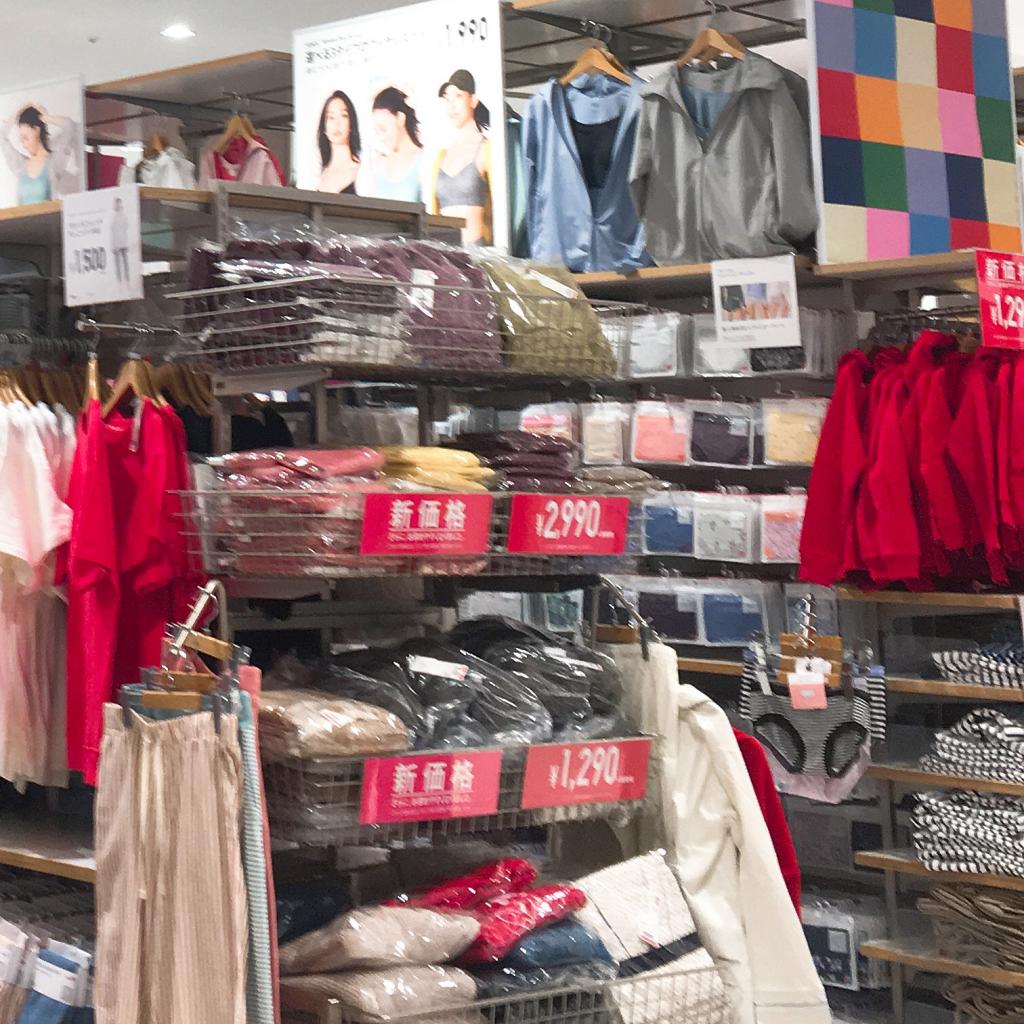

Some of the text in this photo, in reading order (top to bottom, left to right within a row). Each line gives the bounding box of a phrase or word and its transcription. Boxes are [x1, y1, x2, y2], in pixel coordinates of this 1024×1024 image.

[389, 499, 466, 529] 新価格
[392, 758, 475, 794] 新価格
[549, 745, 621, 792] ¥1,290
